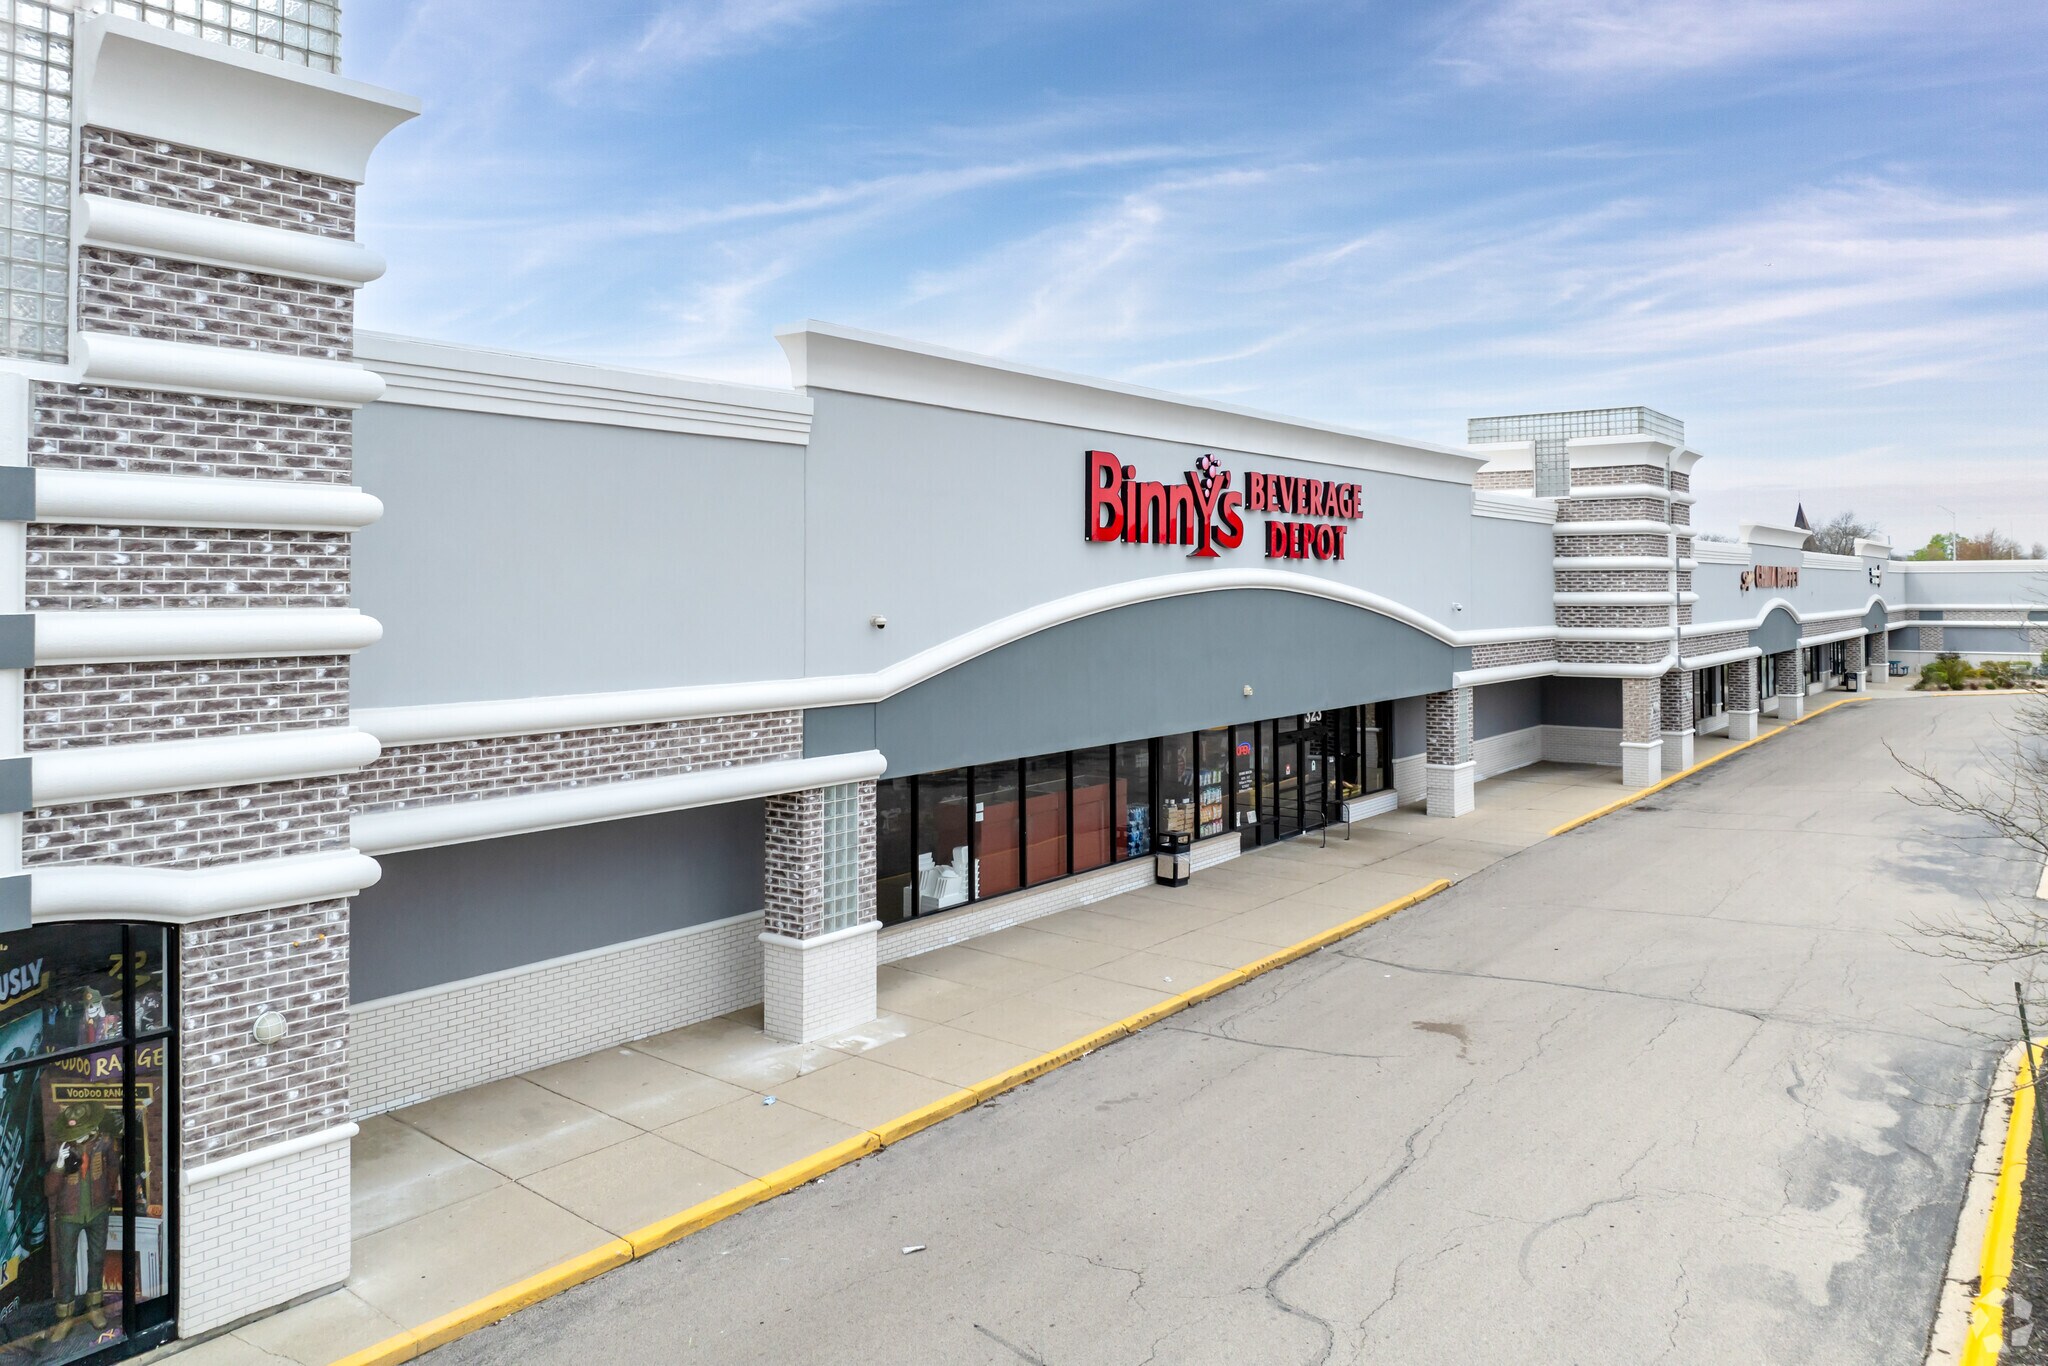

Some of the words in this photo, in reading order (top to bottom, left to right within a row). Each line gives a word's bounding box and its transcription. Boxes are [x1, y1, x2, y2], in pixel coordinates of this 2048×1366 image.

[1244, 471, 1364, 519] BEVERAGE
[1265, 520, 1347, 560] DEPOT
[1305, 711, 1322, 723] 323
[67, 1088, 102, 1098] VOODOO
